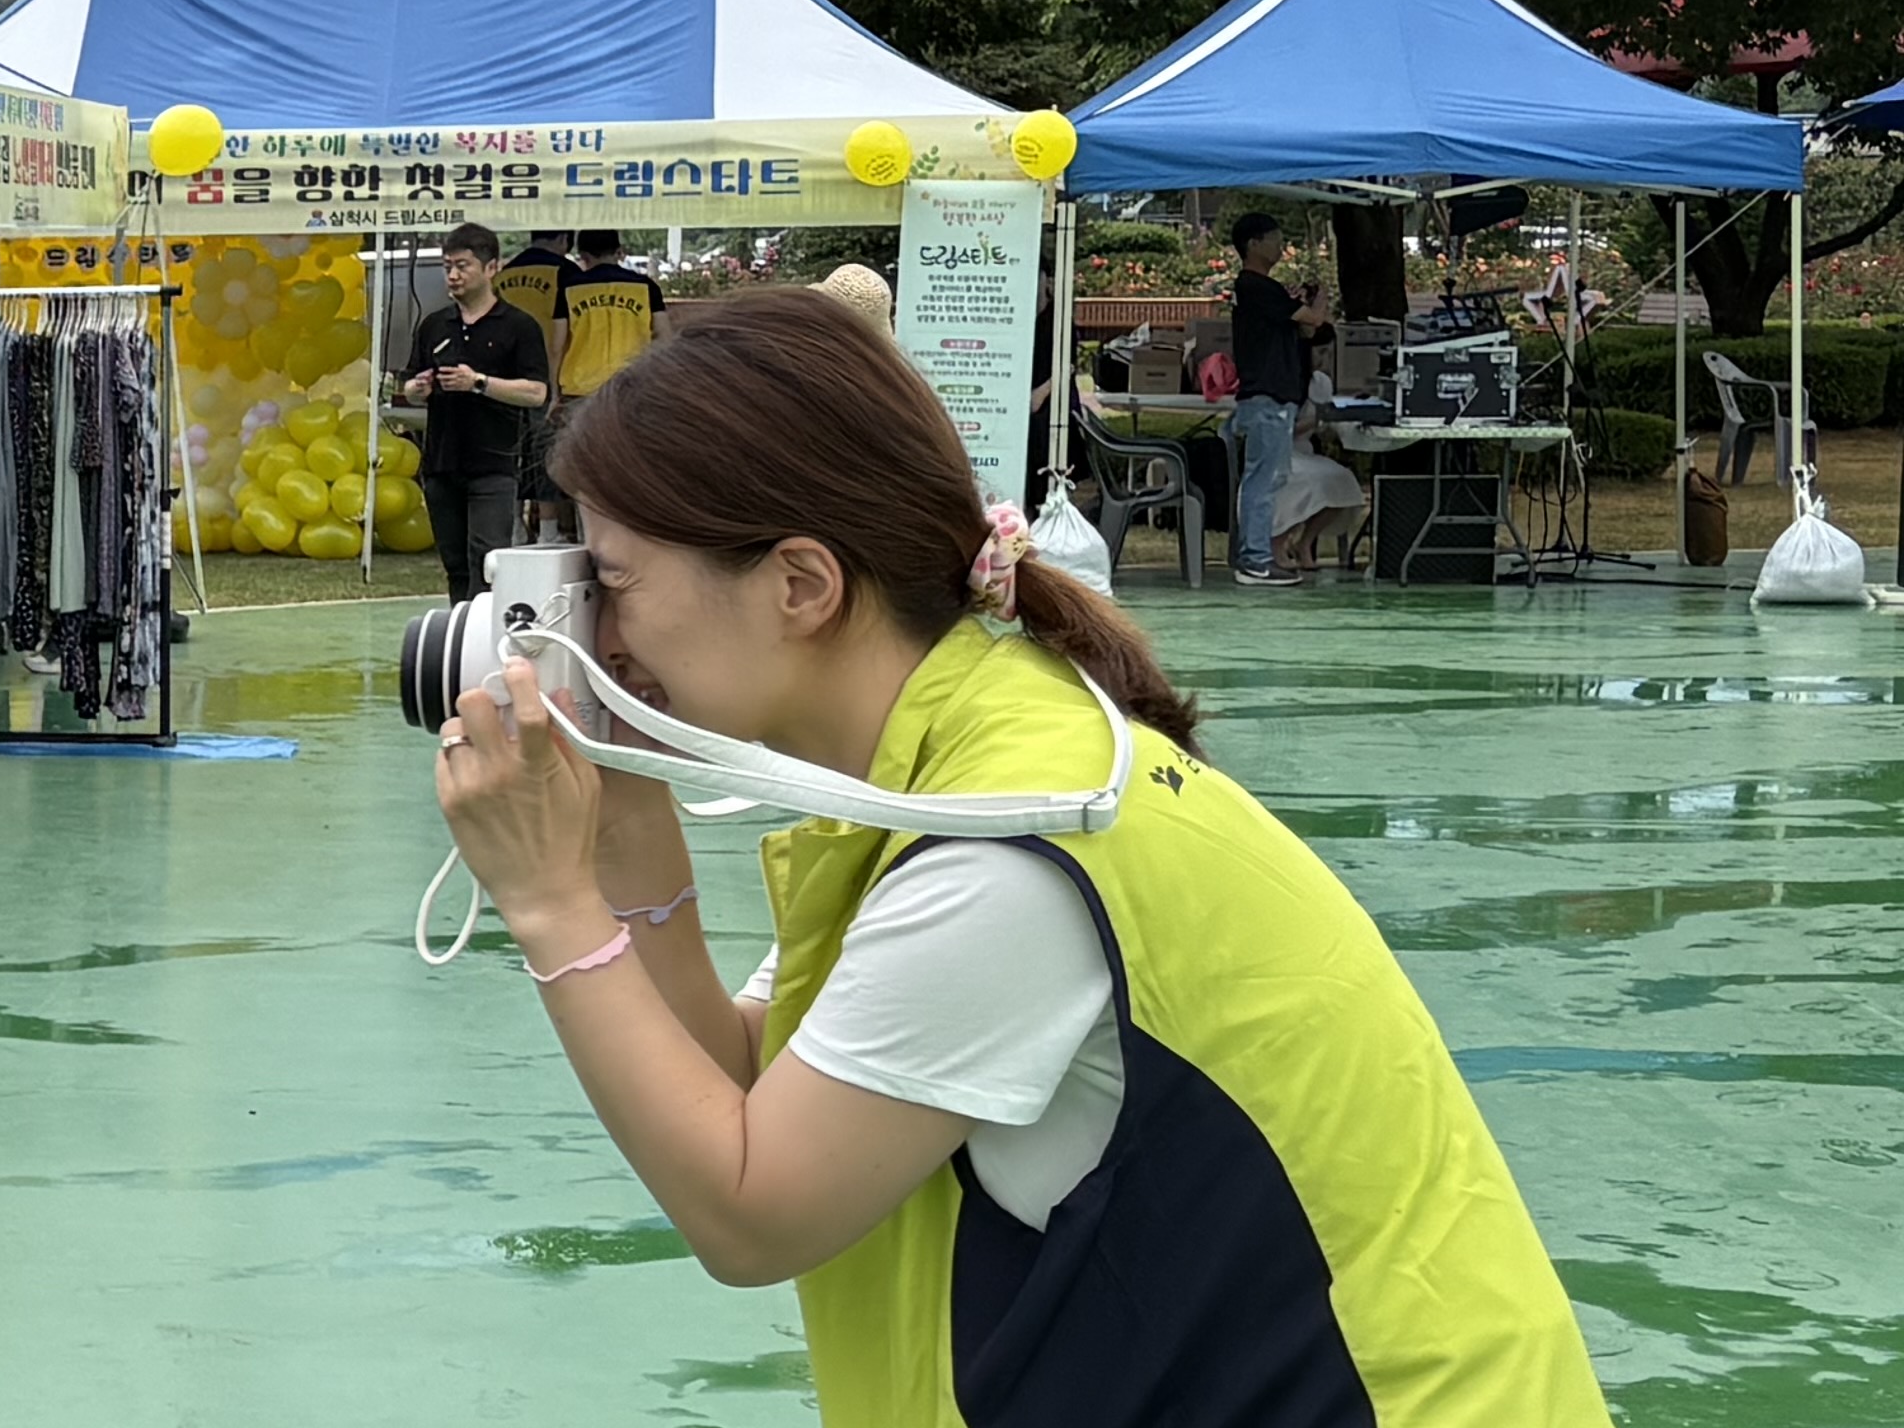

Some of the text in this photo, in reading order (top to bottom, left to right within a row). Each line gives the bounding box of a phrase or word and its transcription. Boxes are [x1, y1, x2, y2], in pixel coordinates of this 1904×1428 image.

[262, 133, 347, 157] 하루에
[360, 131, 441, 156] 특별한
[453, 129, 537, 154] 복지를
[549, 128, 606, 153] 담다
[186, 167, 272, 204] 꿈을
[293, 164, 384, 203] 향한
[404, 162, 541, 201] 첫걸음
[563, 158, 801, 199] 드림스타트
[329, 209, 465, 227] 삼척시 드림스타트
[45, 243, 194, 269] 드림타트
